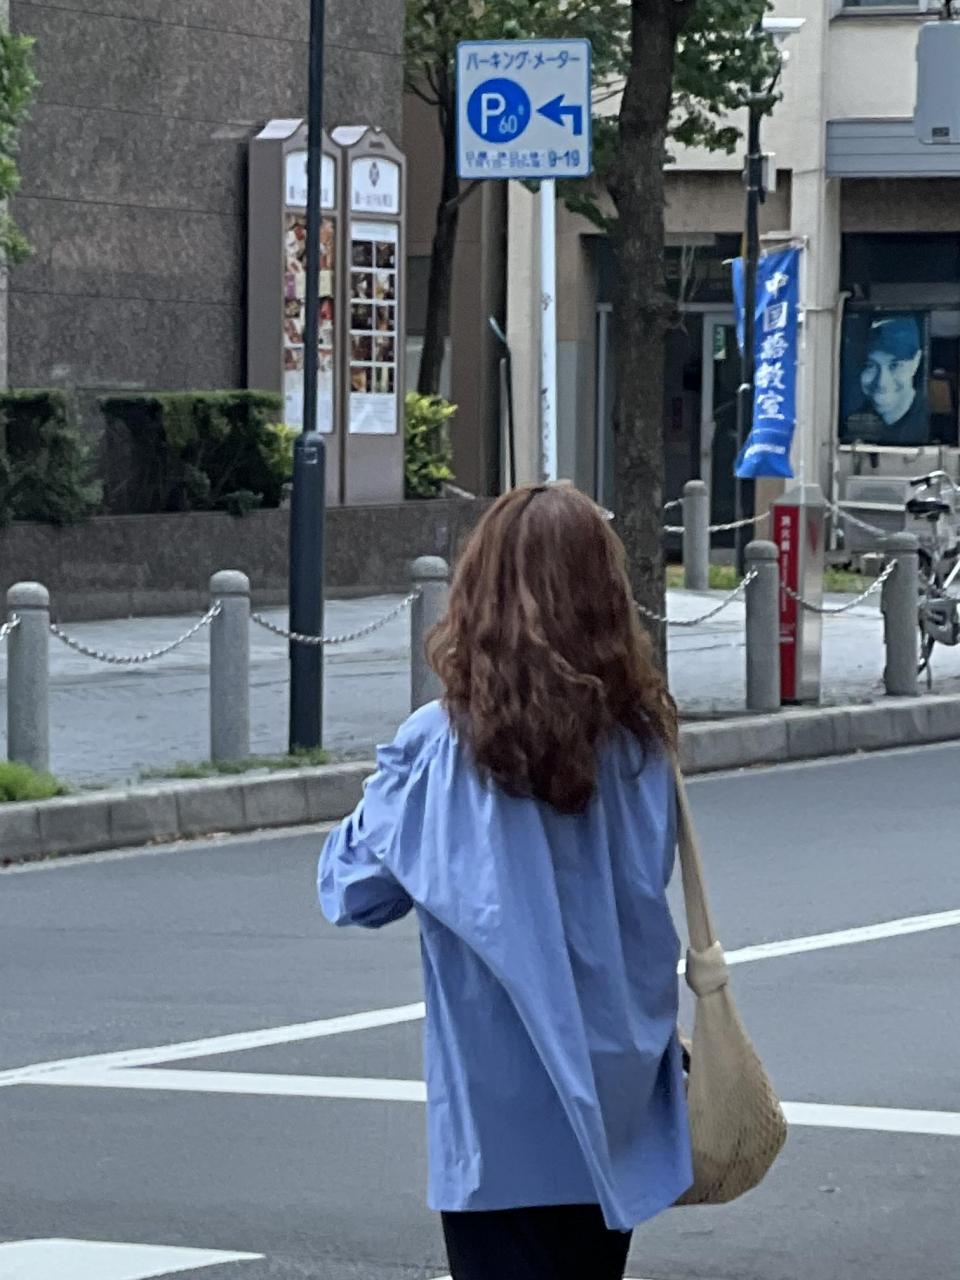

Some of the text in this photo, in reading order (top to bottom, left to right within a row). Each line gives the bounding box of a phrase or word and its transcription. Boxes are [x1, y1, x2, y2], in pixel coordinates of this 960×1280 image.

[480, 92, 518, 136] P 60
[754, 271, 790, 420] 中国語教室
